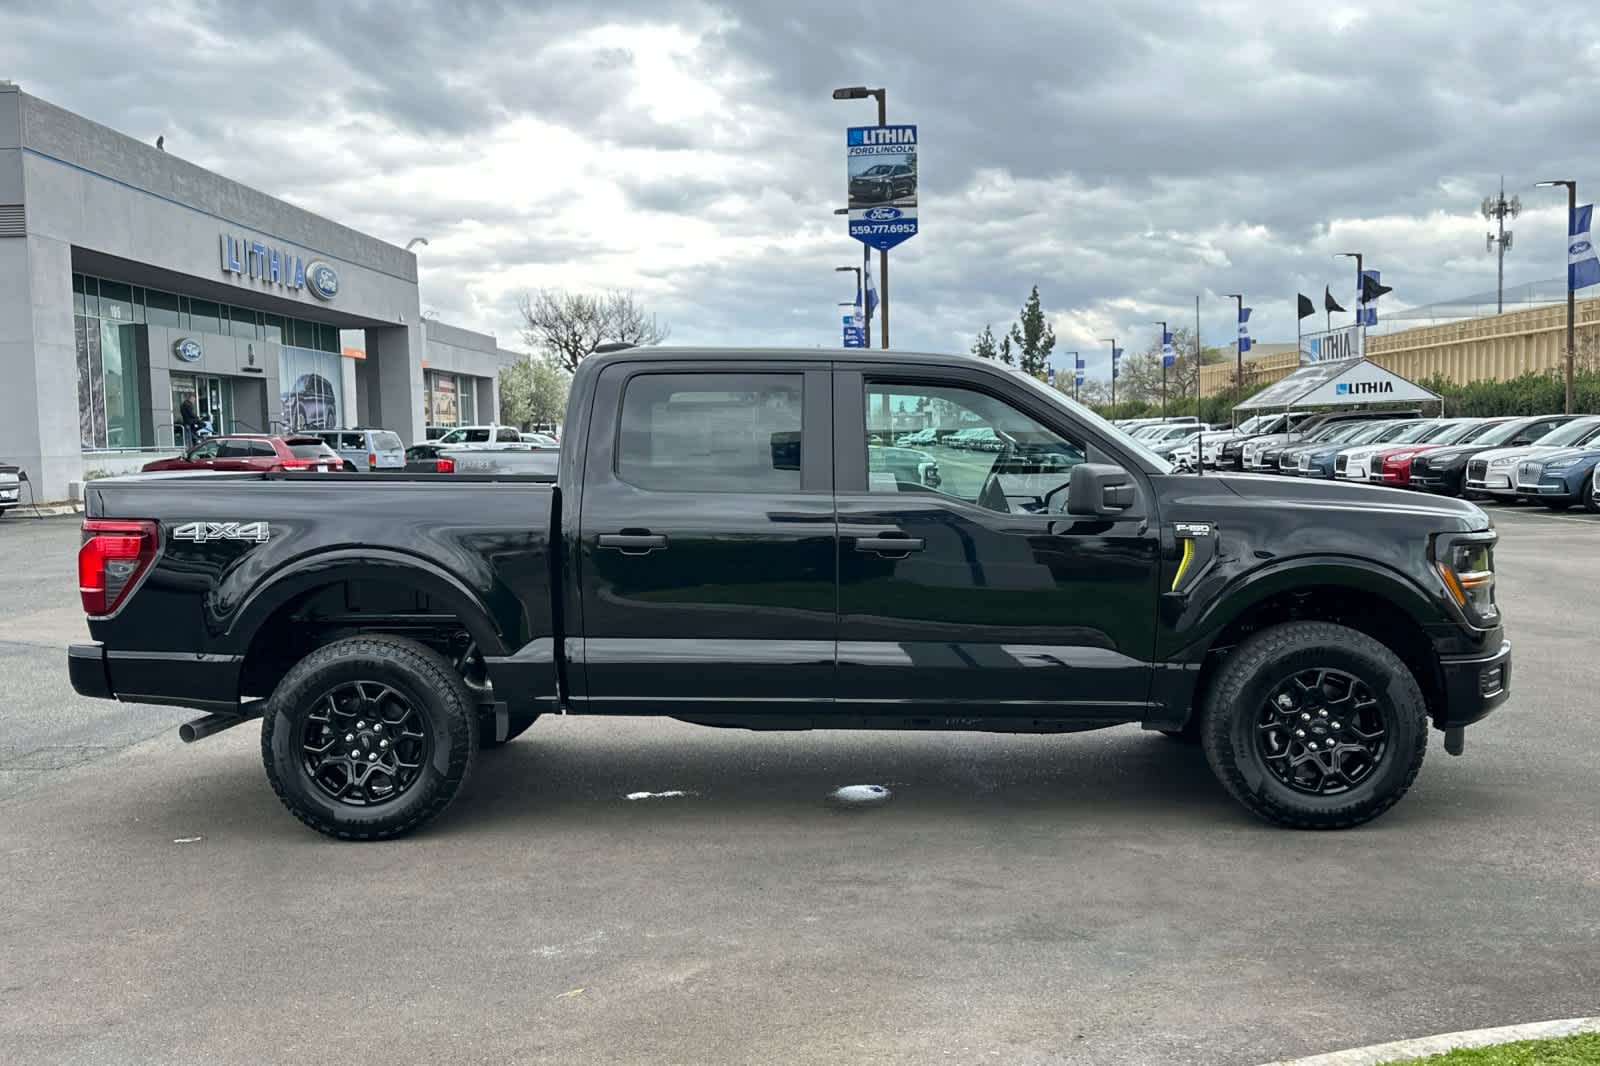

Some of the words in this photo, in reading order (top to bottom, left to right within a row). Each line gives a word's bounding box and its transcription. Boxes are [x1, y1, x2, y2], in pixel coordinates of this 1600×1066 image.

[863, 128, 915, 145] LITHIA
[876, 145, 915, 153] LINCOLN
[870, 208, 897, 219] Ford
[851, 224, 916, 235] 559.777.6952
[219, 232, 305, 290] LITHIA
[1319, 332, 1351, 361] LITHIA
[1348, 381, 1394, 394] LITHIA
